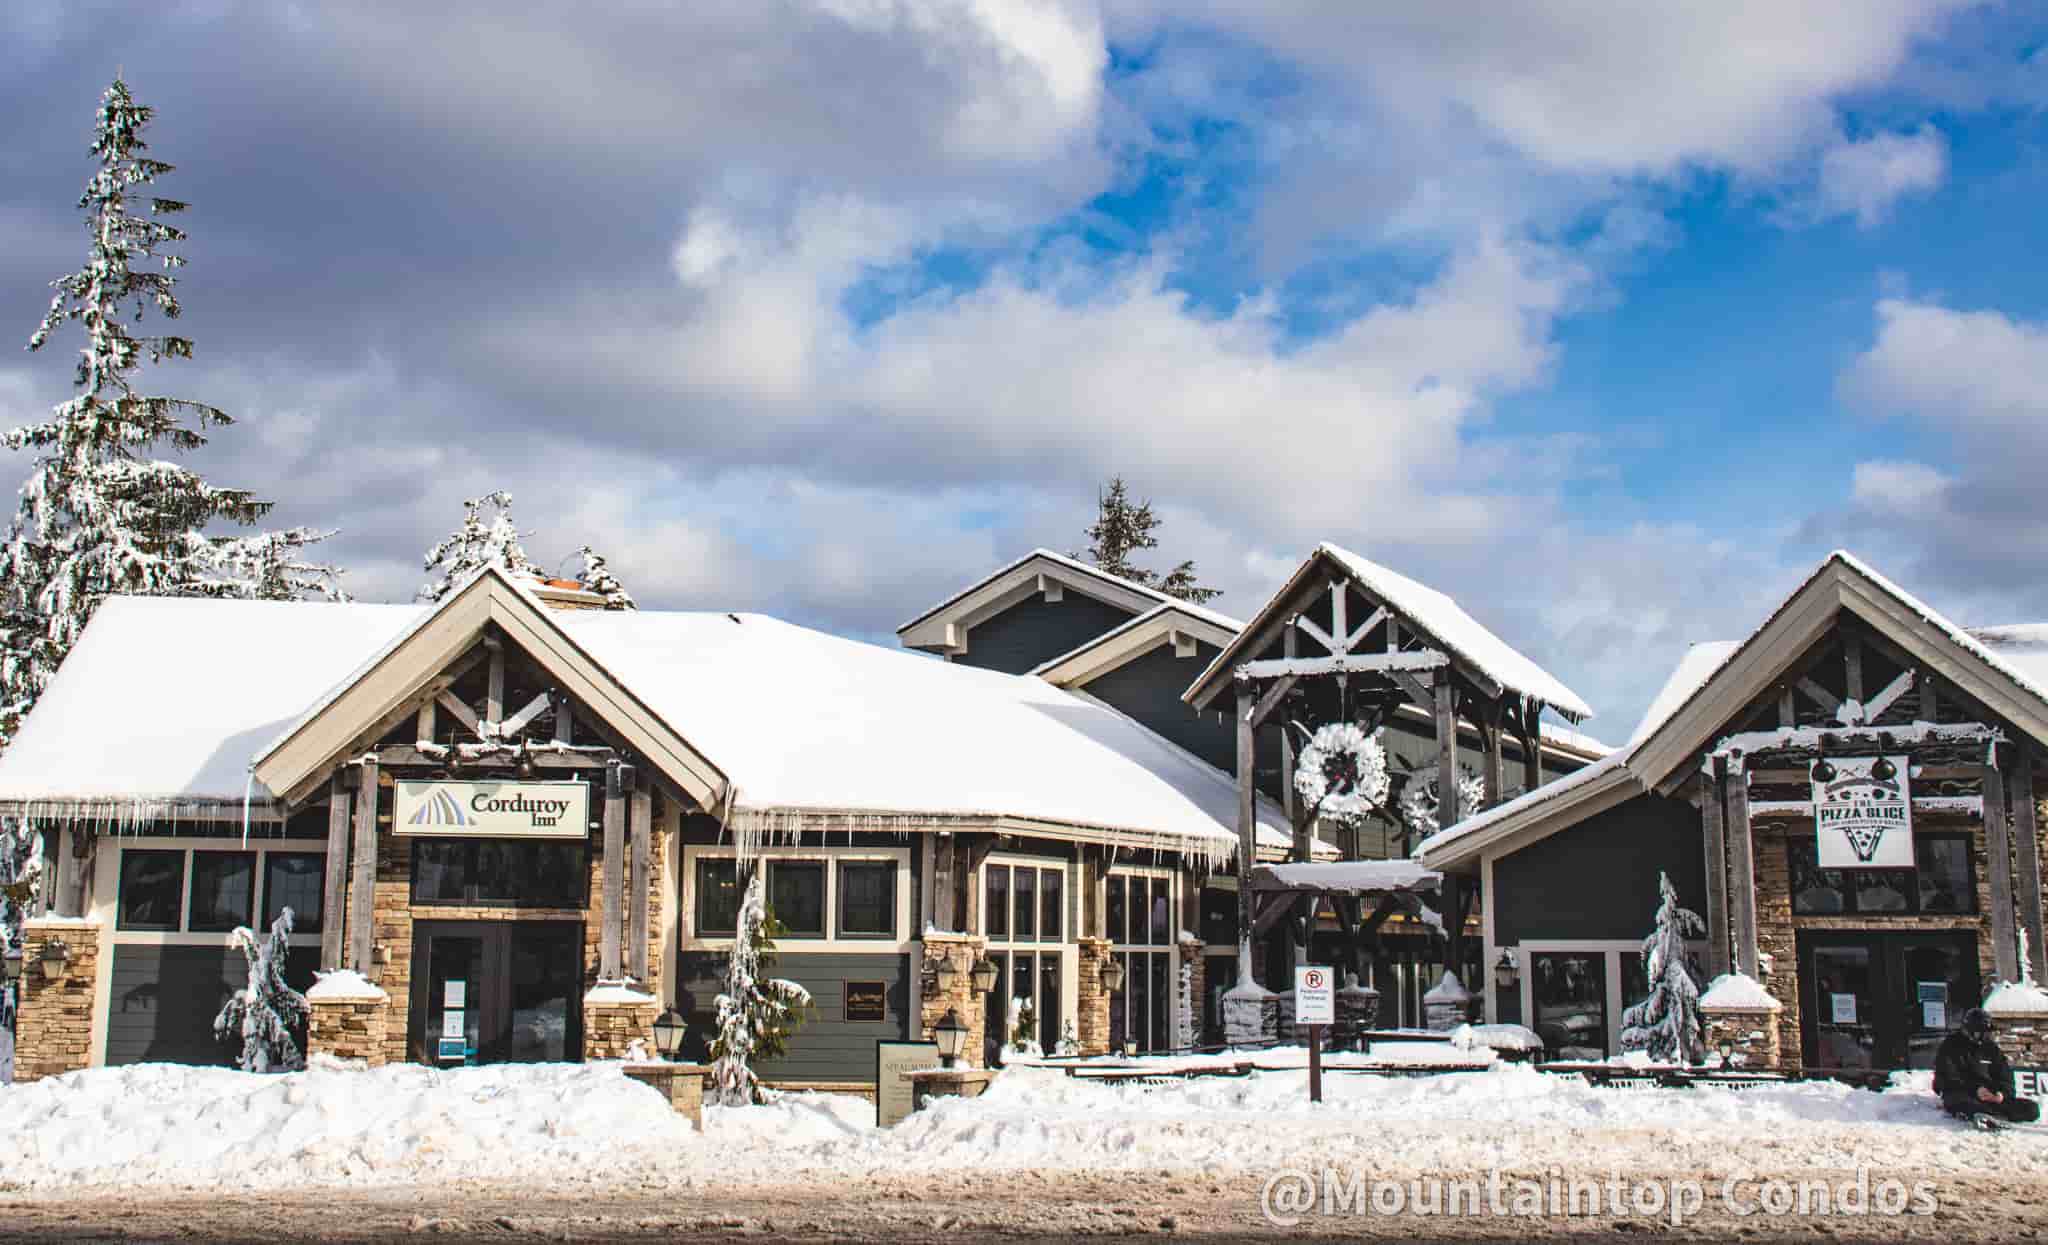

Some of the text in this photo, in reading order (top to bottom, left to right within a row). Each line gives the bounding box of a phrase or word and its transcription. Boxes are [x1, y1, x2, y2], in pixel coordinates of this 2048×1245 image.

[471, 792, 570, 818] Corduroy
[531, 814, 557, 827] Inn
[1820, 807, 1861, 821] PIZZA
